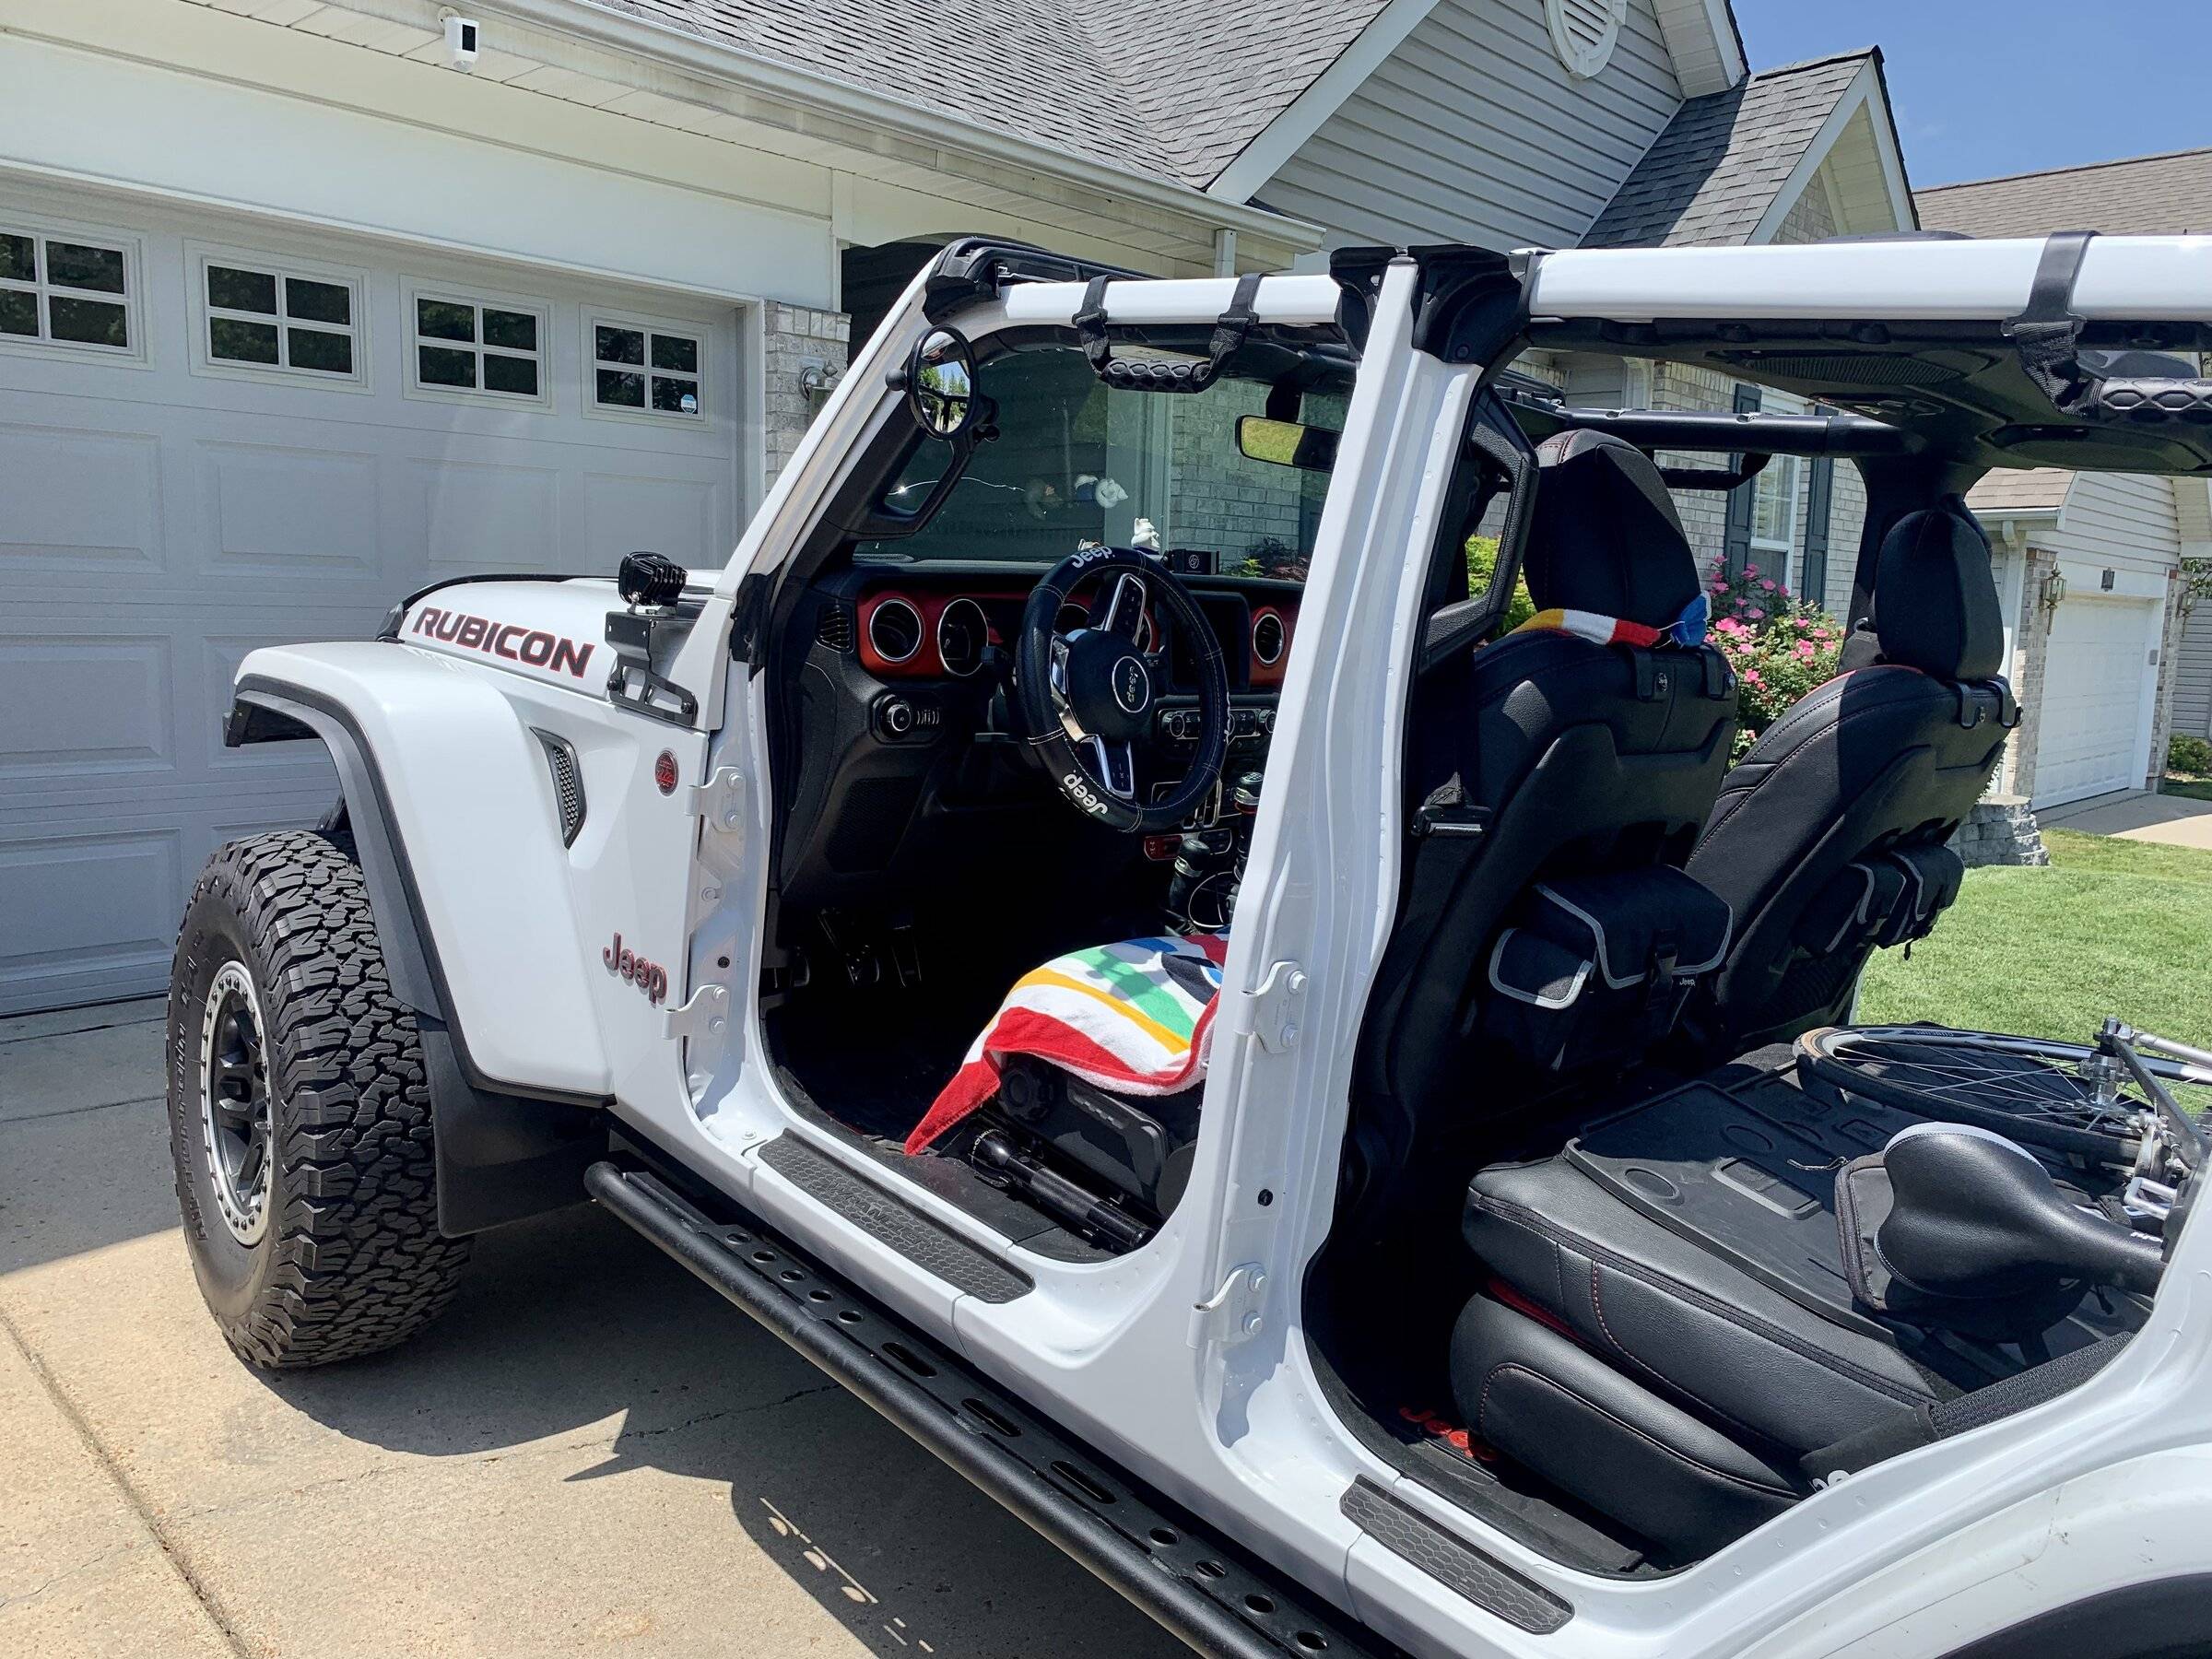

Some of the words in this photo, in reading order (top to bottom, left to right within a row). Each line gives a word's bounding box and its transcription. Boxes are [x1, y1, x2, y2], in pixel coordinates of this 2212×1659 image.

[1072, 547, 1112, 568] Jeep
[412, 606, 594, 678] RUBICON
[1064, 773, 1109, 814] Jeep
[603, 932, 667, 1005] Jeep
[1679, 977, 1696, 986] Jeep
